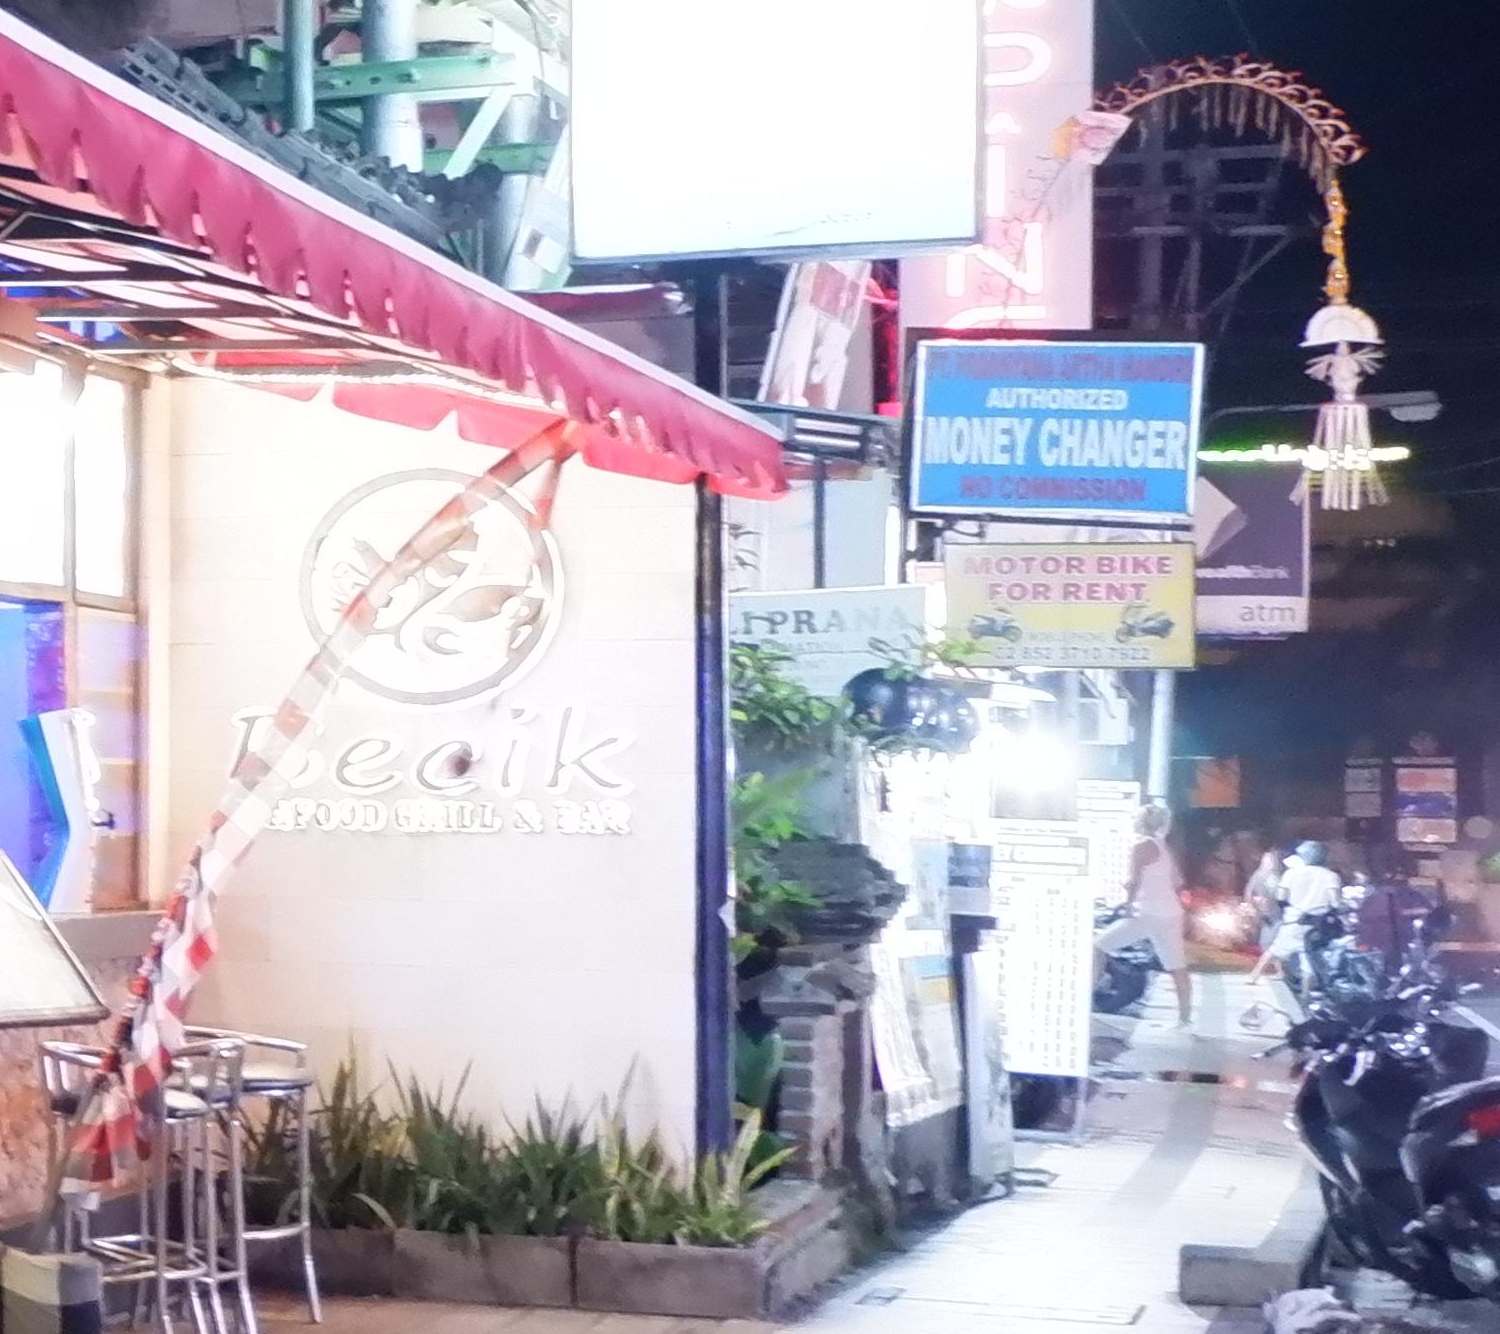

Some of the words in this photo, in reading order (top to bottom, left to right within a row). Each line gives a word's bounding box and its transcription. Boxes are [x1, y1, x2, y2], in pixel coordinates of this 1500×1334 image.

[985, 387, 1128, 411] AUTHORIZED
[923, 416, 1032, 466] MONEY
[1037, 418, 1188, 470] CHANGER
[963, 554, 1095, 577] MOTOR
[1099, 555, 1175, 576] BIKE
[987, 581, 1057, 602] FOR
[1060, 581, 1150, 603] RENT
[1239, 603, 1296, 623] atm
